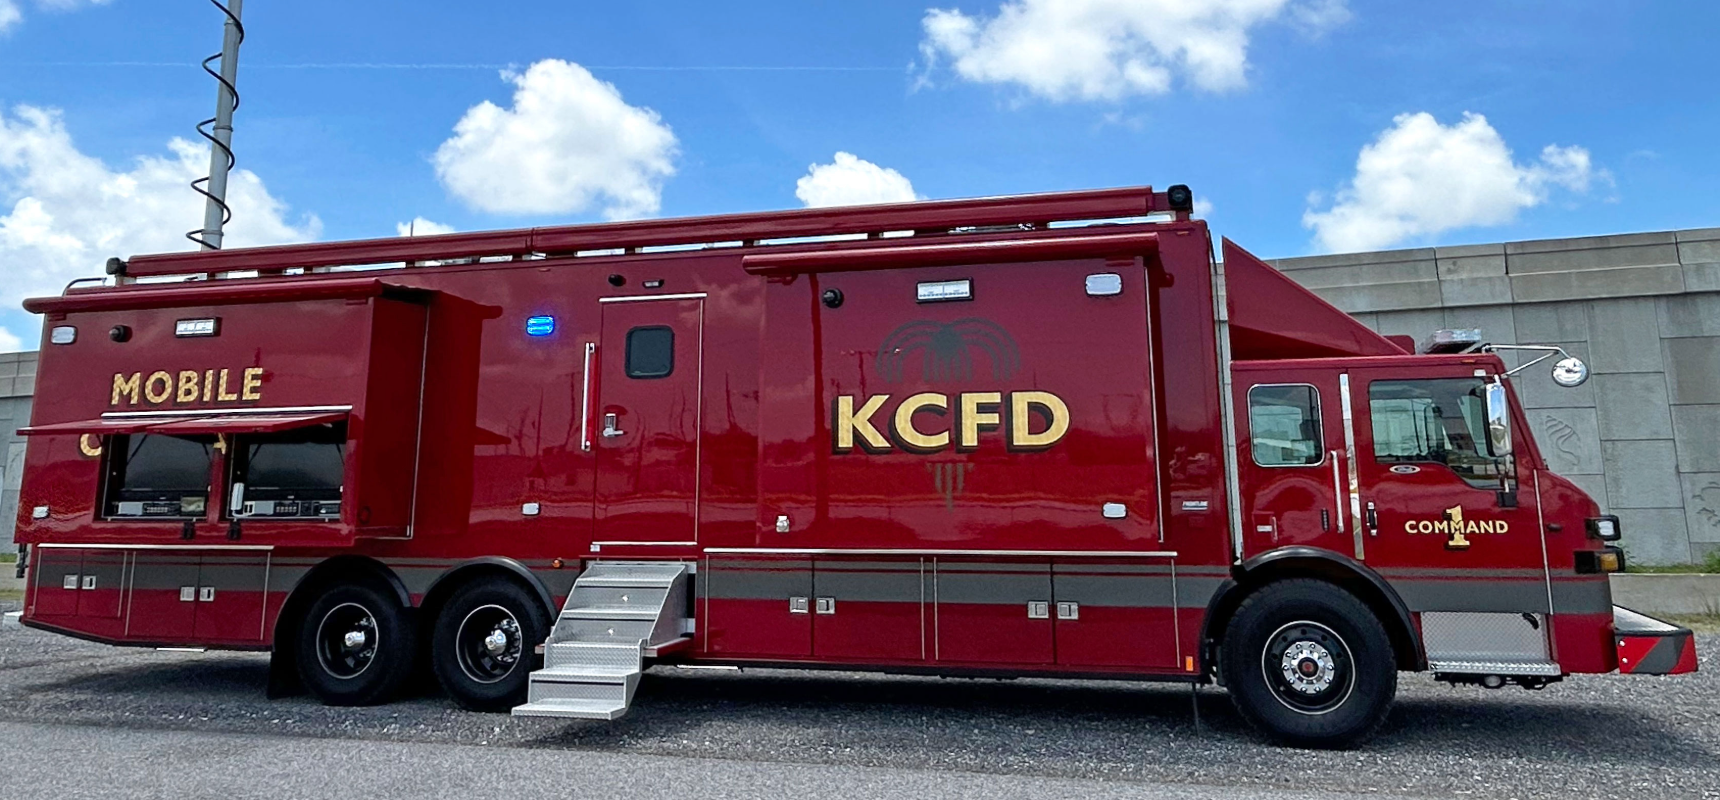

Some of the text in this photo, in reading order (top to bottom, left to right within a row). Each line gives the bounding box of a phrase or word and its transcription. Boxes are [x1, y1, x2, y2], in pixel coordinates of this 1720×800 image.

[110, 367, 264, 406] MOBILE
[833, 391, 1071, 452] KCFD
[1404, 519, 1509, 535] COMMAND
[1445, 505, 1470, 547] 1
